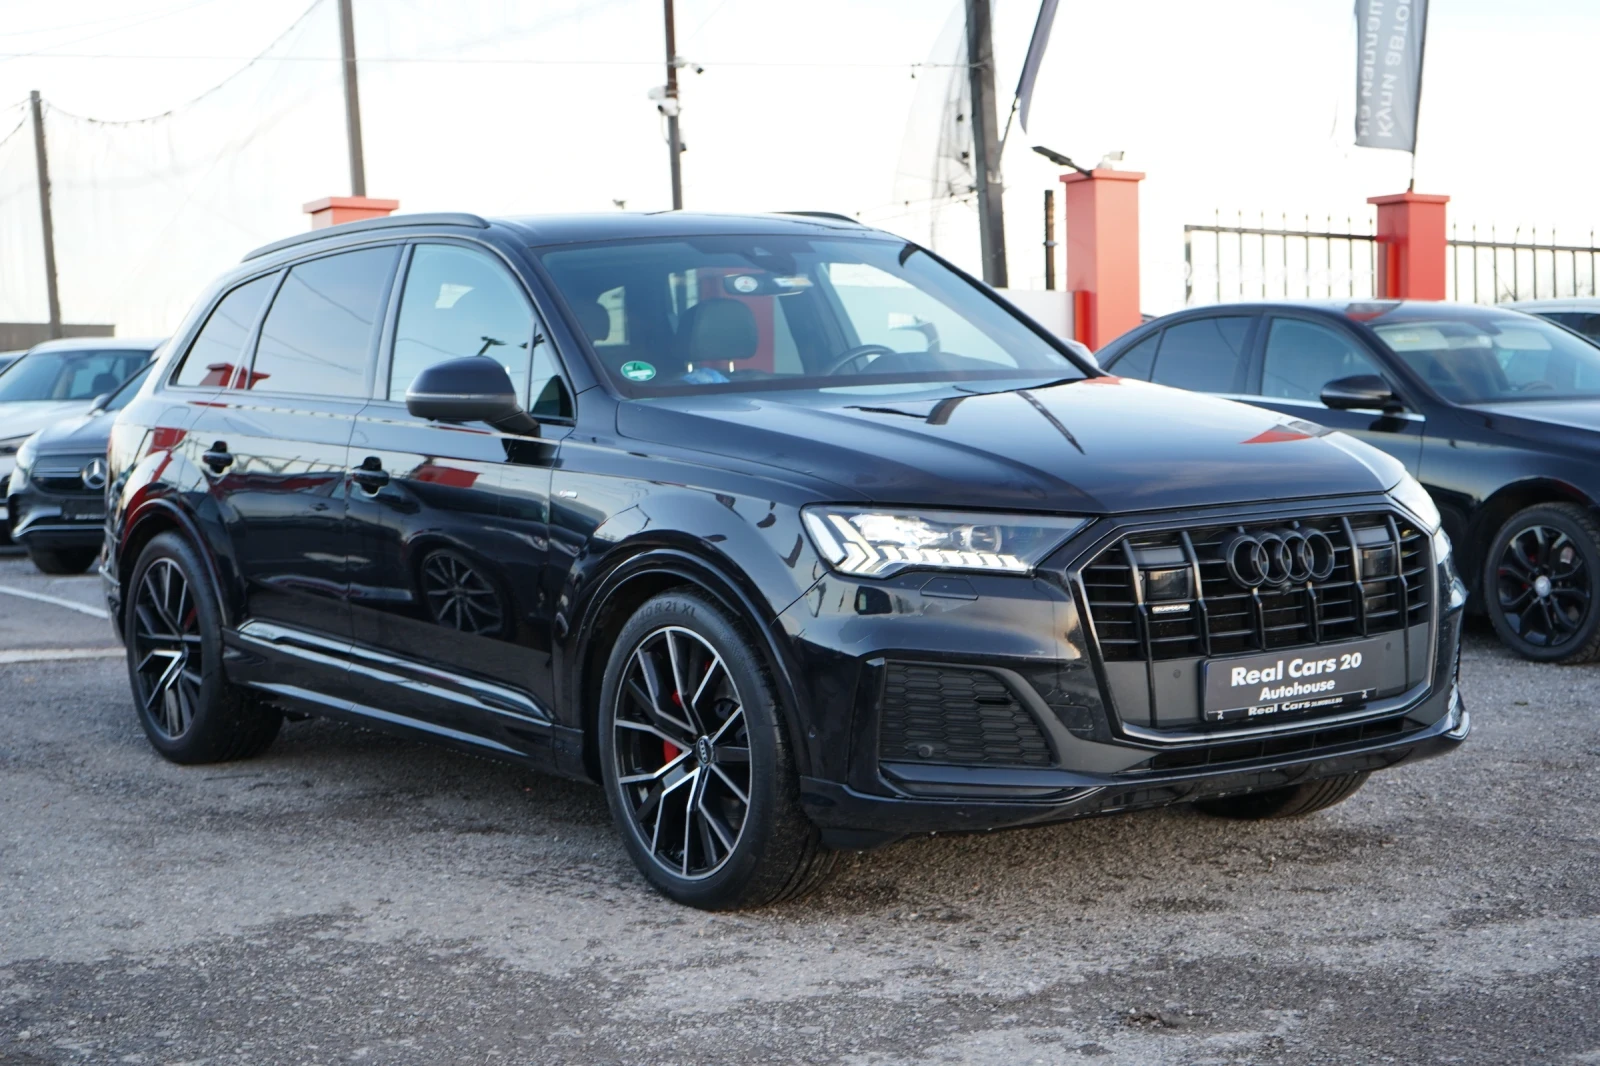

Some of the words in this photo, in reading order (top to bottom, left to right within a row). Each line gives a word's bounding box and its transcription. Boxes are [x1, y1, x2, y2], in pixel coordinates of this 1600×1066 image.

[1230, 660, 1284, 687] Real
[1288, 658, 1337, 678] Cars
[1339, 652, 1362, 671] 20
[1259, 679, 1336, 701] Autohouse
[1248, 703, 1279, 716] Real
[1281, 701, 1311, 712] Cars
